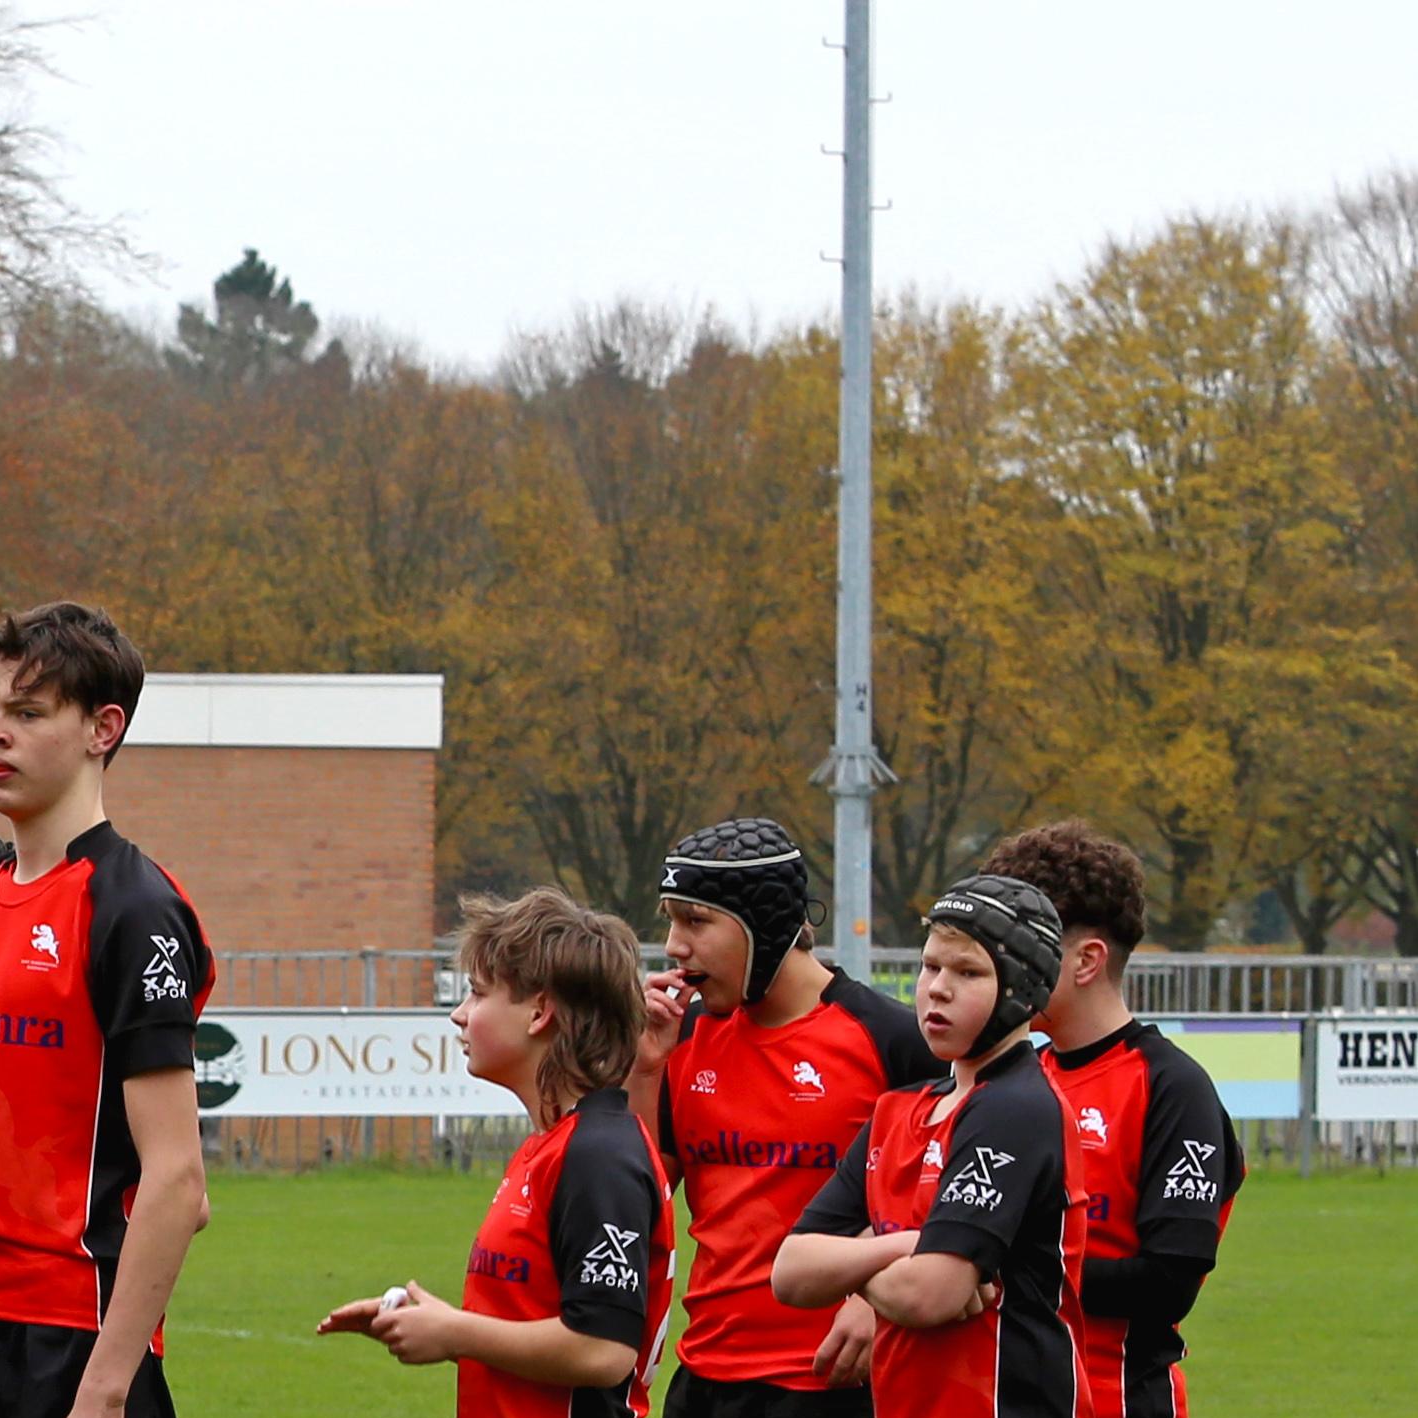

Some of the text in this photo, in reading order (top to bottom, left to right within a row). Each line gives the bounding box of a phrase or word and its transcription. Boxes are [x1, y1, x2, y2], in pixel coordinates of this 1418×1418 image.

[259, 1033, 396, 1076] LONG
[319, 1085, 469, 1098] RESTAURANT
[944, 1181, 1003, 1205] XAVI
[1163, 1188, 1215, 1203] SPORT
[1165, 1177, 1217, 1196] XAVI
[940, 1192, 999, 1212] SPORT
[581, 1260, 639, 1285] XAVI
[579, 1273, 639, 1293] SPORT
